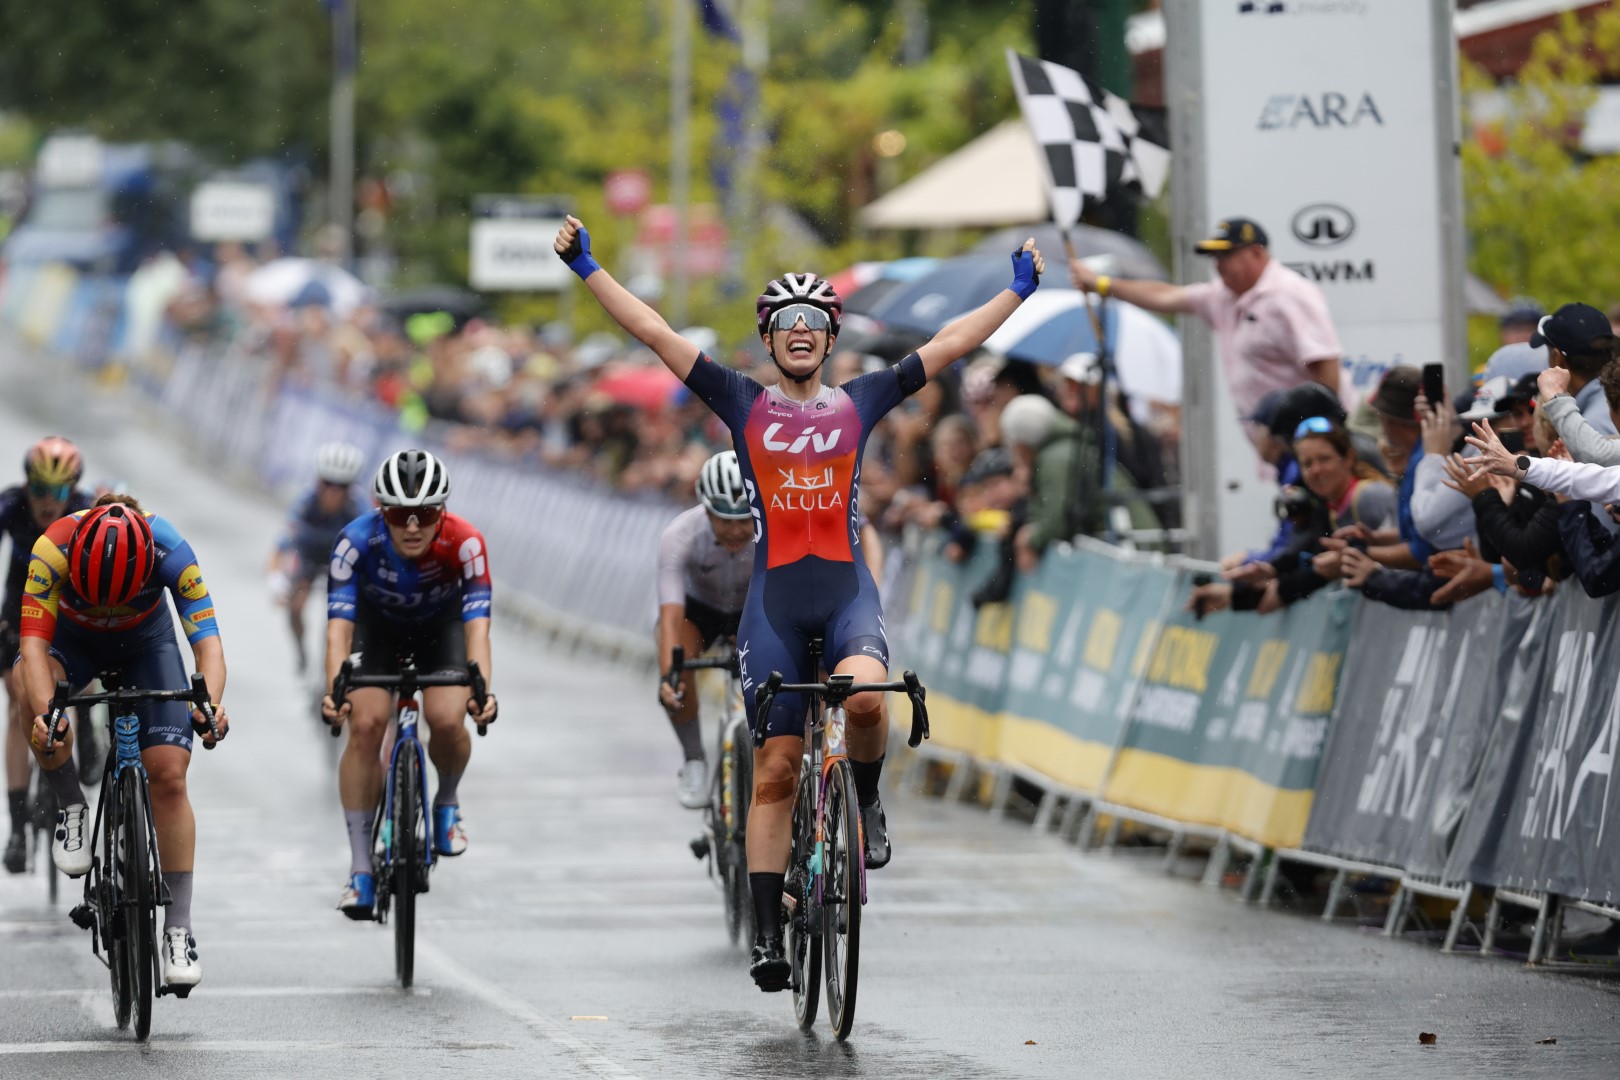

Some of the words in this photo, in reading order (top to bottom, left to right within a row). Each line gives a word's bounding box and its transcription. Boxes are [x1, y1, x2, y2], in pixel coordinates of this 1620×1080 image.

[767, 409, 793, 417] Jayco
[763, 422, 842, 454] Liv
[770, 491, 843, 512] ALULA
